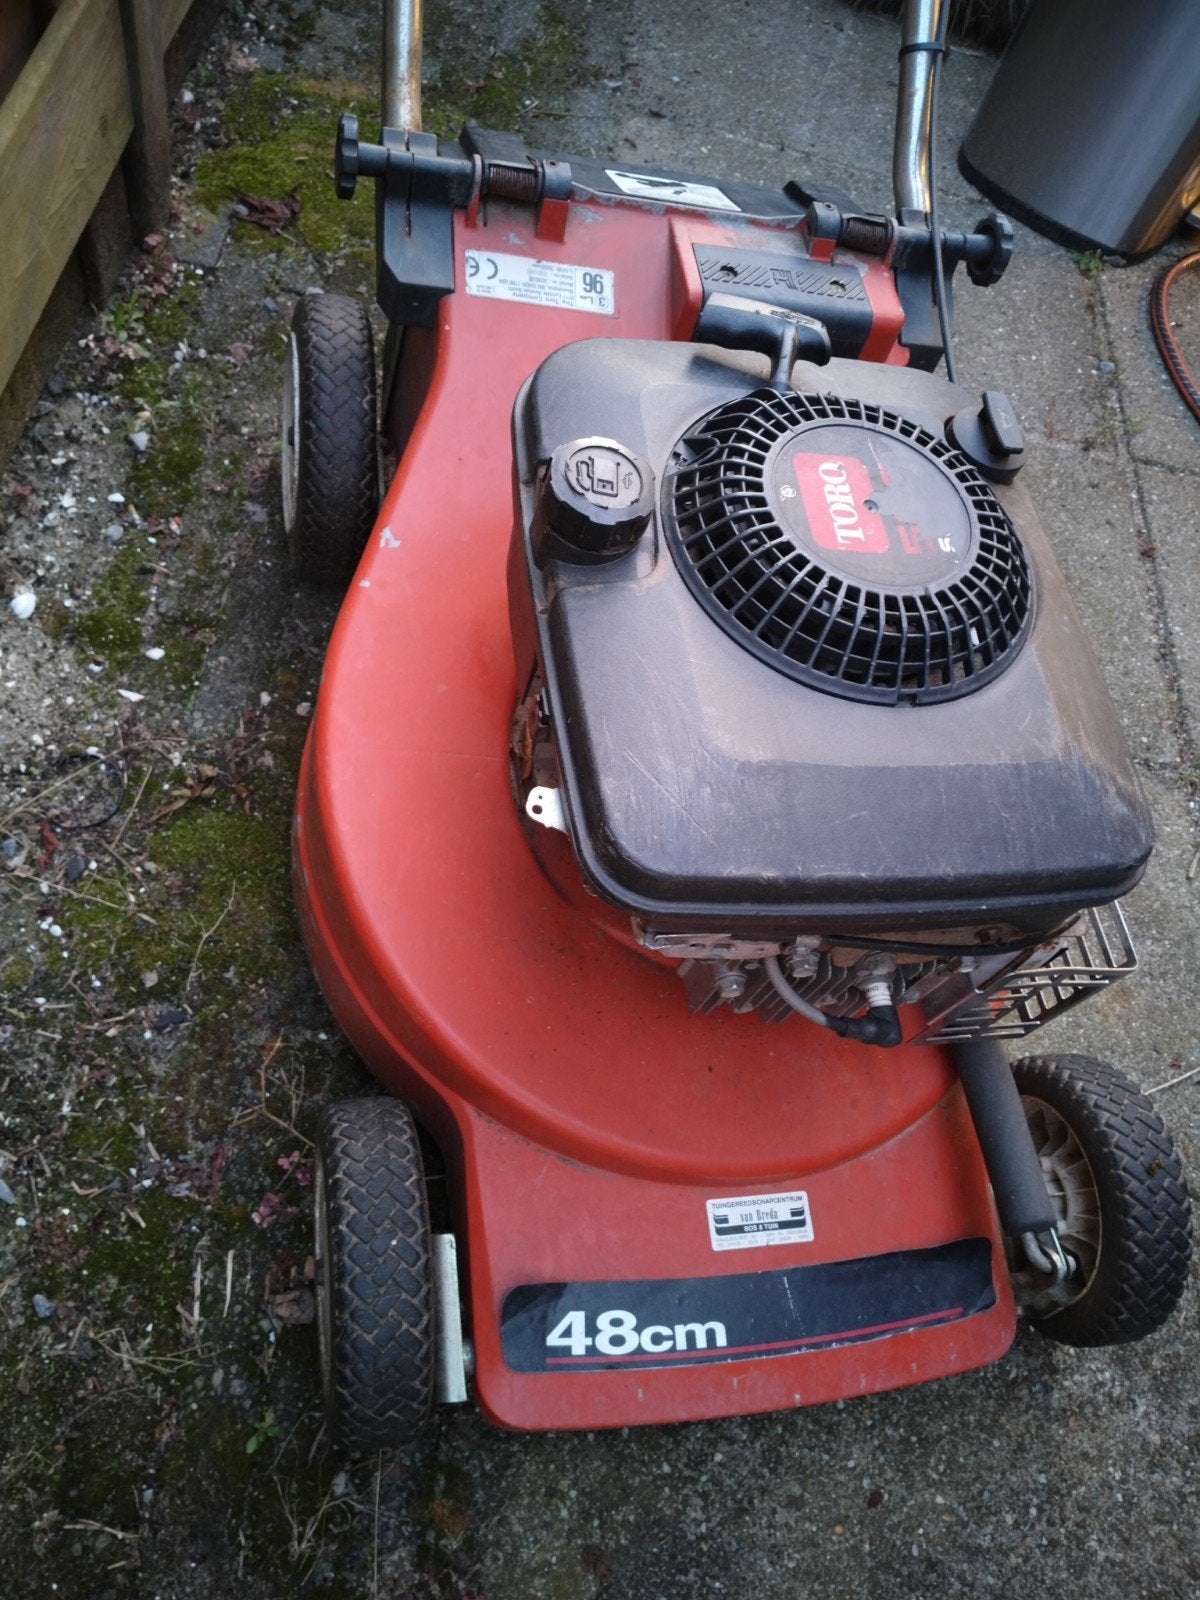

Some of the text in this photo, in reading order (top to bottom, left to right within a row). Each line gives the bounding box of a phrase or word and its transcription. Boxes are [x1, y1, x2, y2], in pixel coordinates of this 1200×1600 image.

[582, 272, 604, 295] 96
[512, 292, 543, 301] Company
[598, 298, 605, 306] 3
[818, 460, 865, 544] TORO
[711, 1196, 803, 1209] TUINGEREEDSCHAPCENTRUM
[740, 1208, 779, 1222] van Breda
[743, 1224, 758, 1232] BOS
[545, 1309, 728, 1356] 48cm
